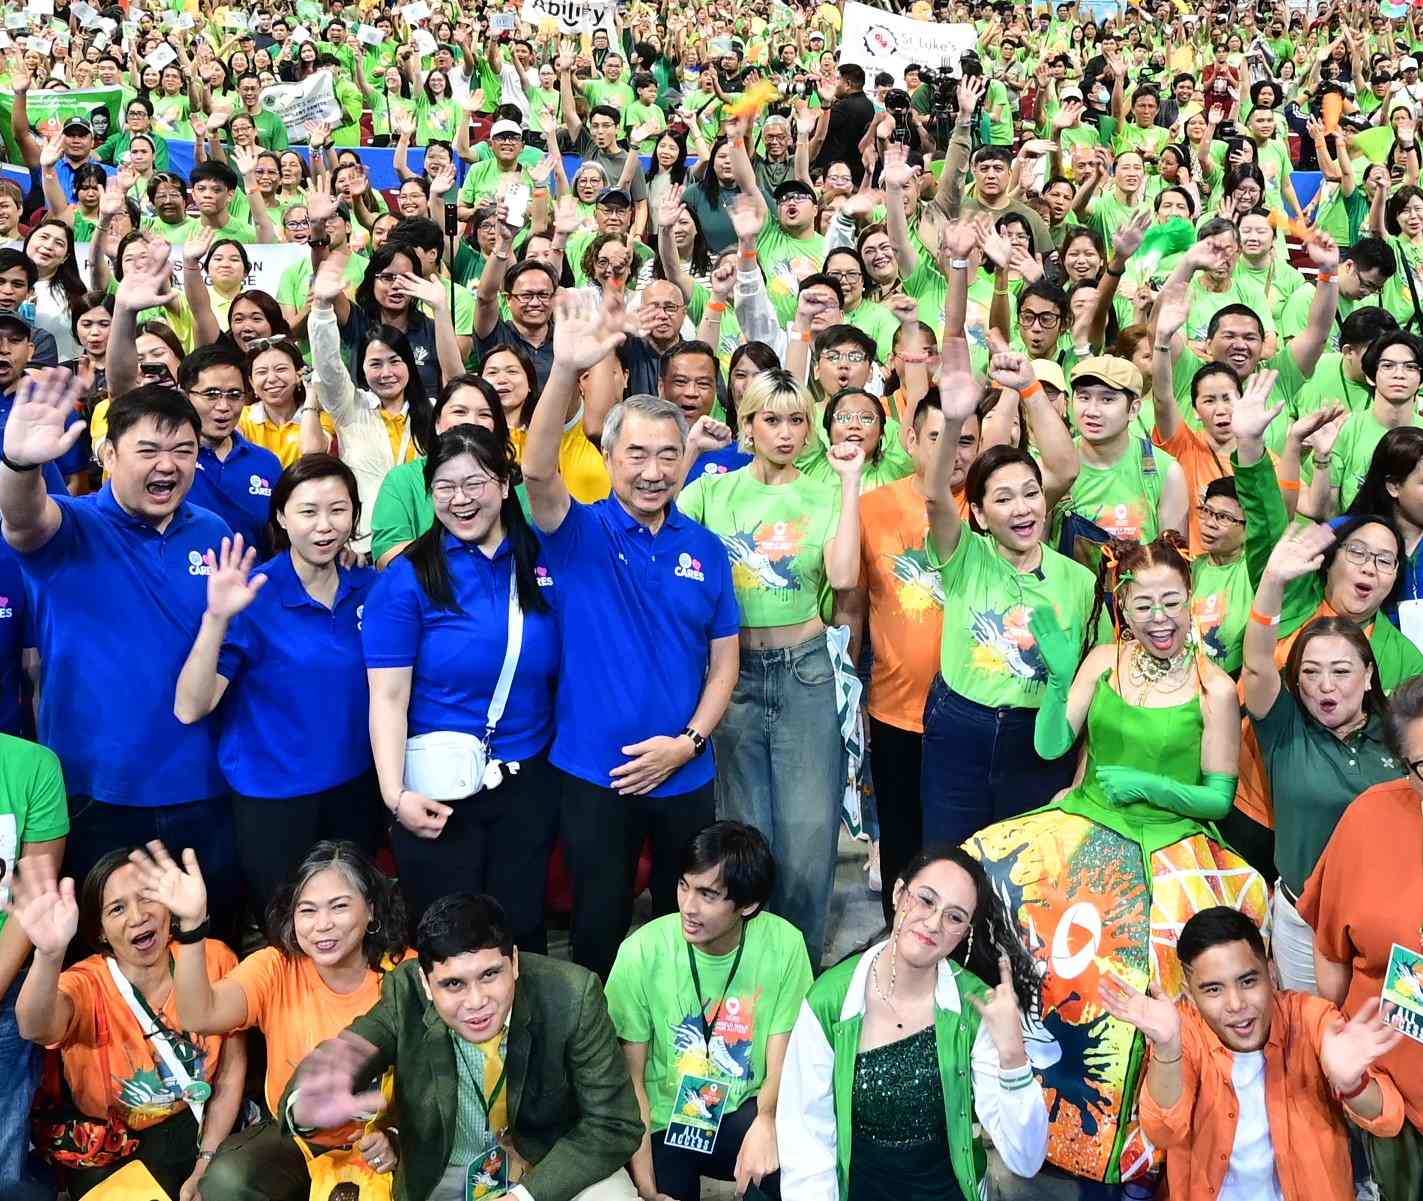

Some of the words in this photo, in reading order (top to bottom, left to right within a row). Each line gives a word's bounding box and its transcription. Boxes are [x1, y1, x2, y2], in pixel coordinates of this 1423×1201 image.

[188, 563, 213, 576] CARE
[675, 566, 704, 582] CARES
[536, 576, 554, 587] RES
[1397, 1006, 1417, 1022] ALL
[681, 1125, 702, 1138] ALL
[670, 1132, 711, 1151] ACCESS
